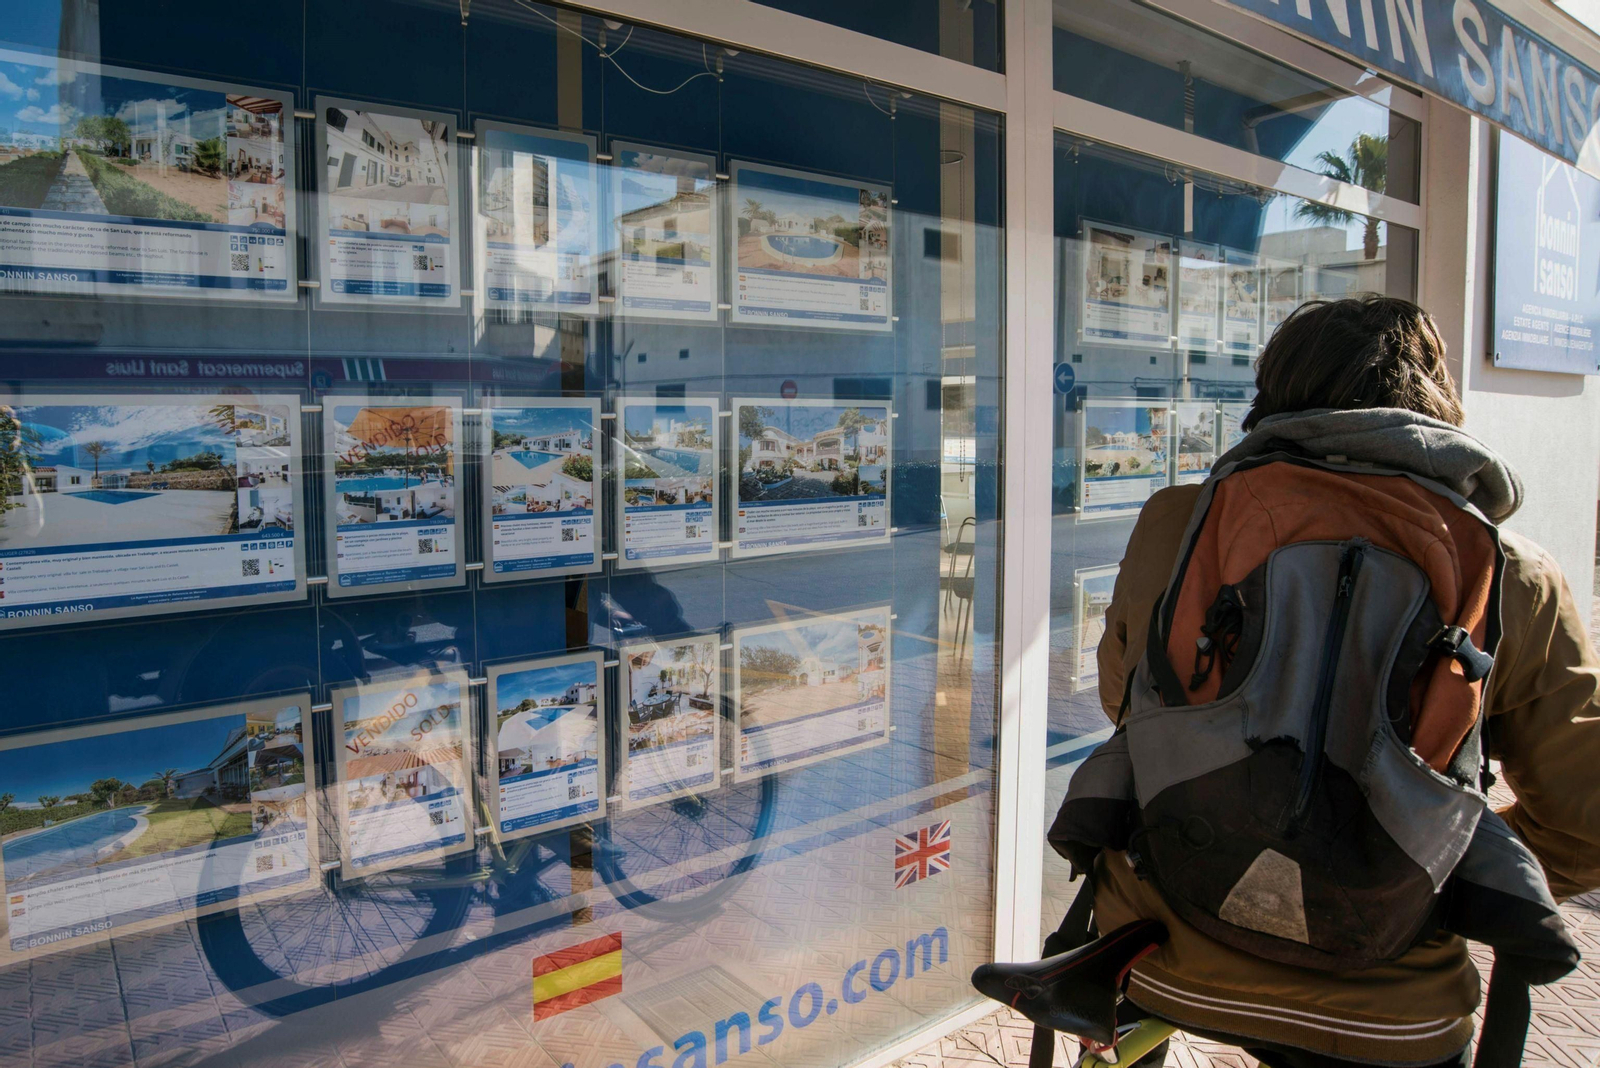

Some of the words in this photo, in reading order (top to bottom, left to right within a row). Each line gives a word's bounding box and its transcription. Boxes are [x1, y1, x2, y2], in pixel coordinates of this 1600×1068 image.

[1540, 211, 1576, 258] bonnin
[38, 272, 78, 281] SANSO
[1539, 258, 1574, 301] sanso
[1513, 316, 1531, 328] ESTATE
[1532, 319, 1550, 332] AGENTS
[340, 414, 416, 466] VENDIDO
[408, 432, 448, 461] OLD
[8, 608, 52, 618] BONNIN
[55, 604, 94, 614] SANSO
[345, 693, 418, 754] VENDIDO
[410, 704, 451, 742] SOLD
[29, 930, 73, 948] BONNIN
[75, 920, 113, 936] SANSO
[562, 927, 948, 1068] anso.com
